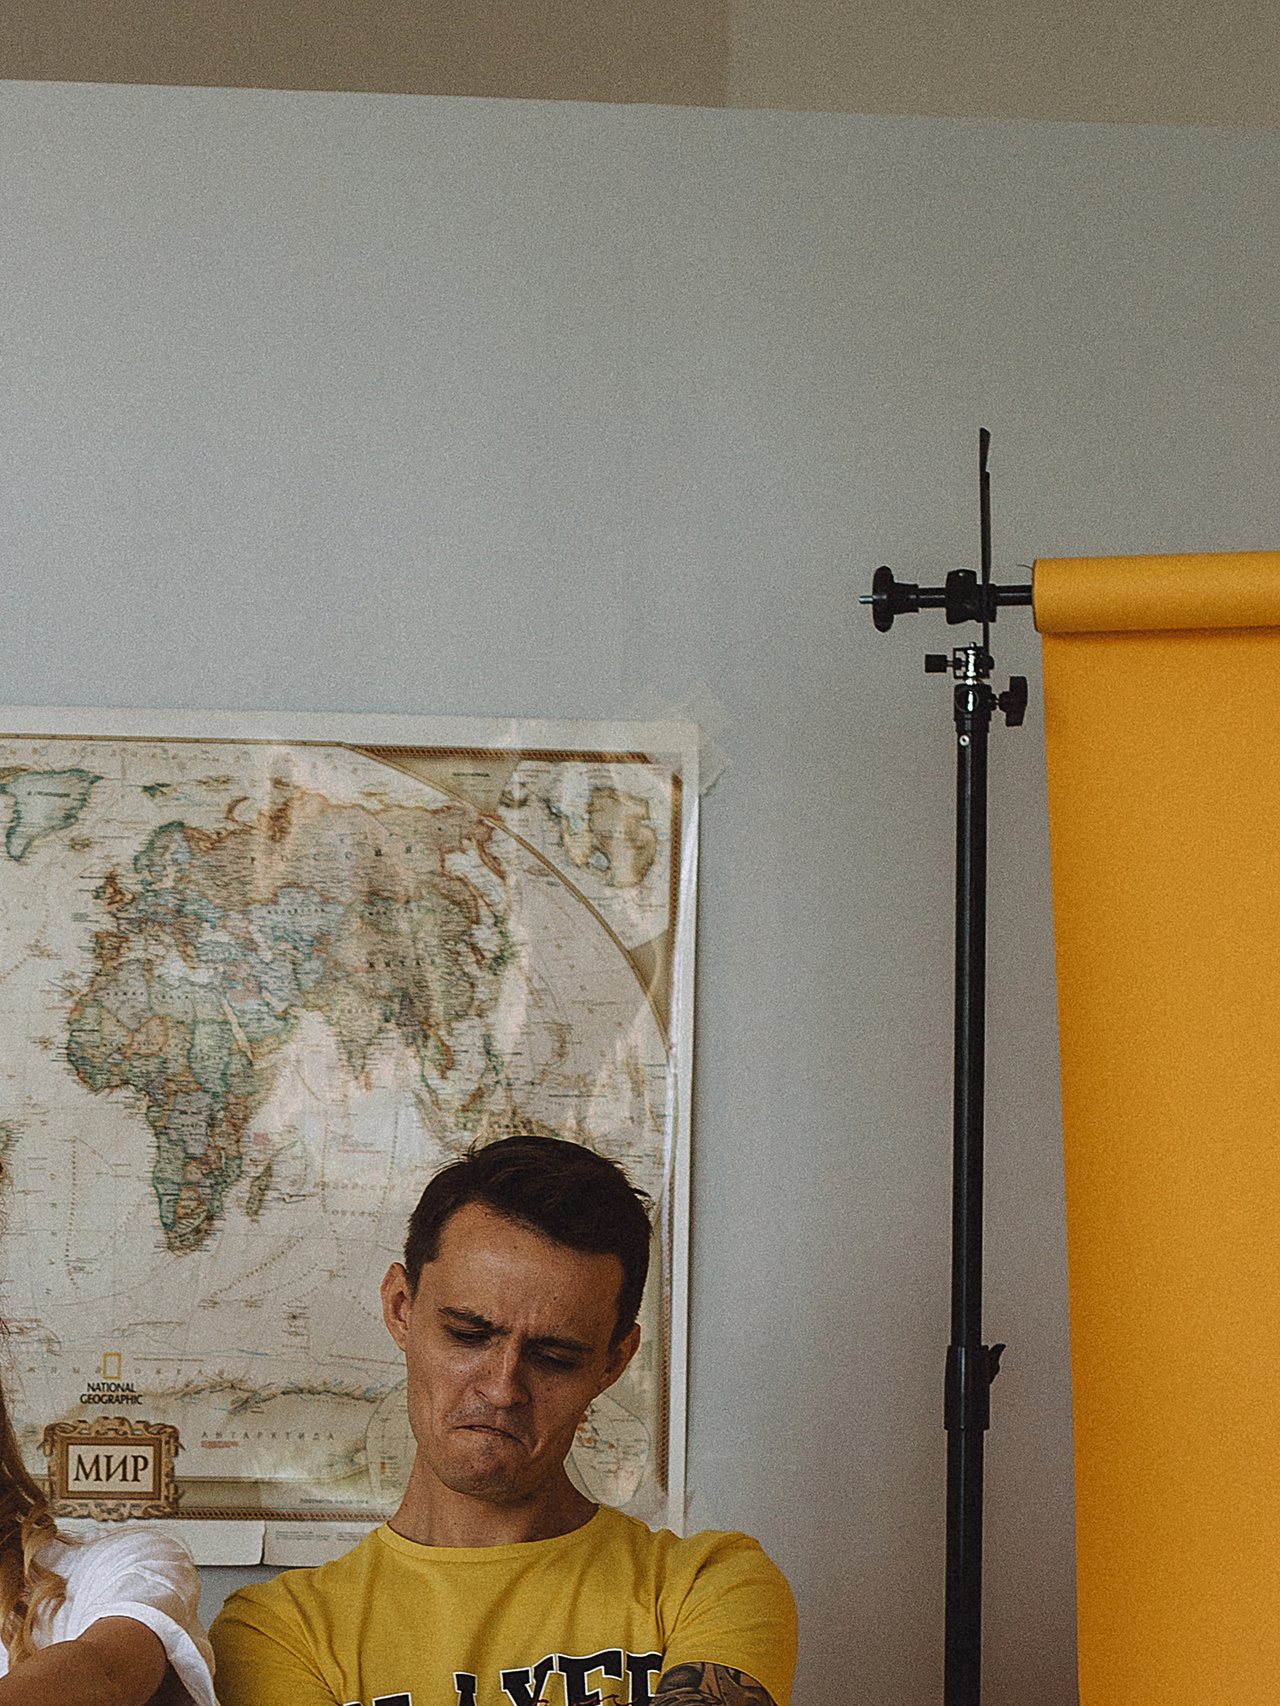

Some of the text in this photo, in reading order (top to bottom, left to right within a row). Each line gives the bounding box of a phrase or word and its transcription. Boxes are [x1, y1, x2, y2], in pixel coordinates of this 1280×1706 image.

[86, 1382, 136, 1393] NATIONAL
[79, 1393, 143, 1405] GEOGRAPHIC
[73, 1453, 149, 1482] МИР
